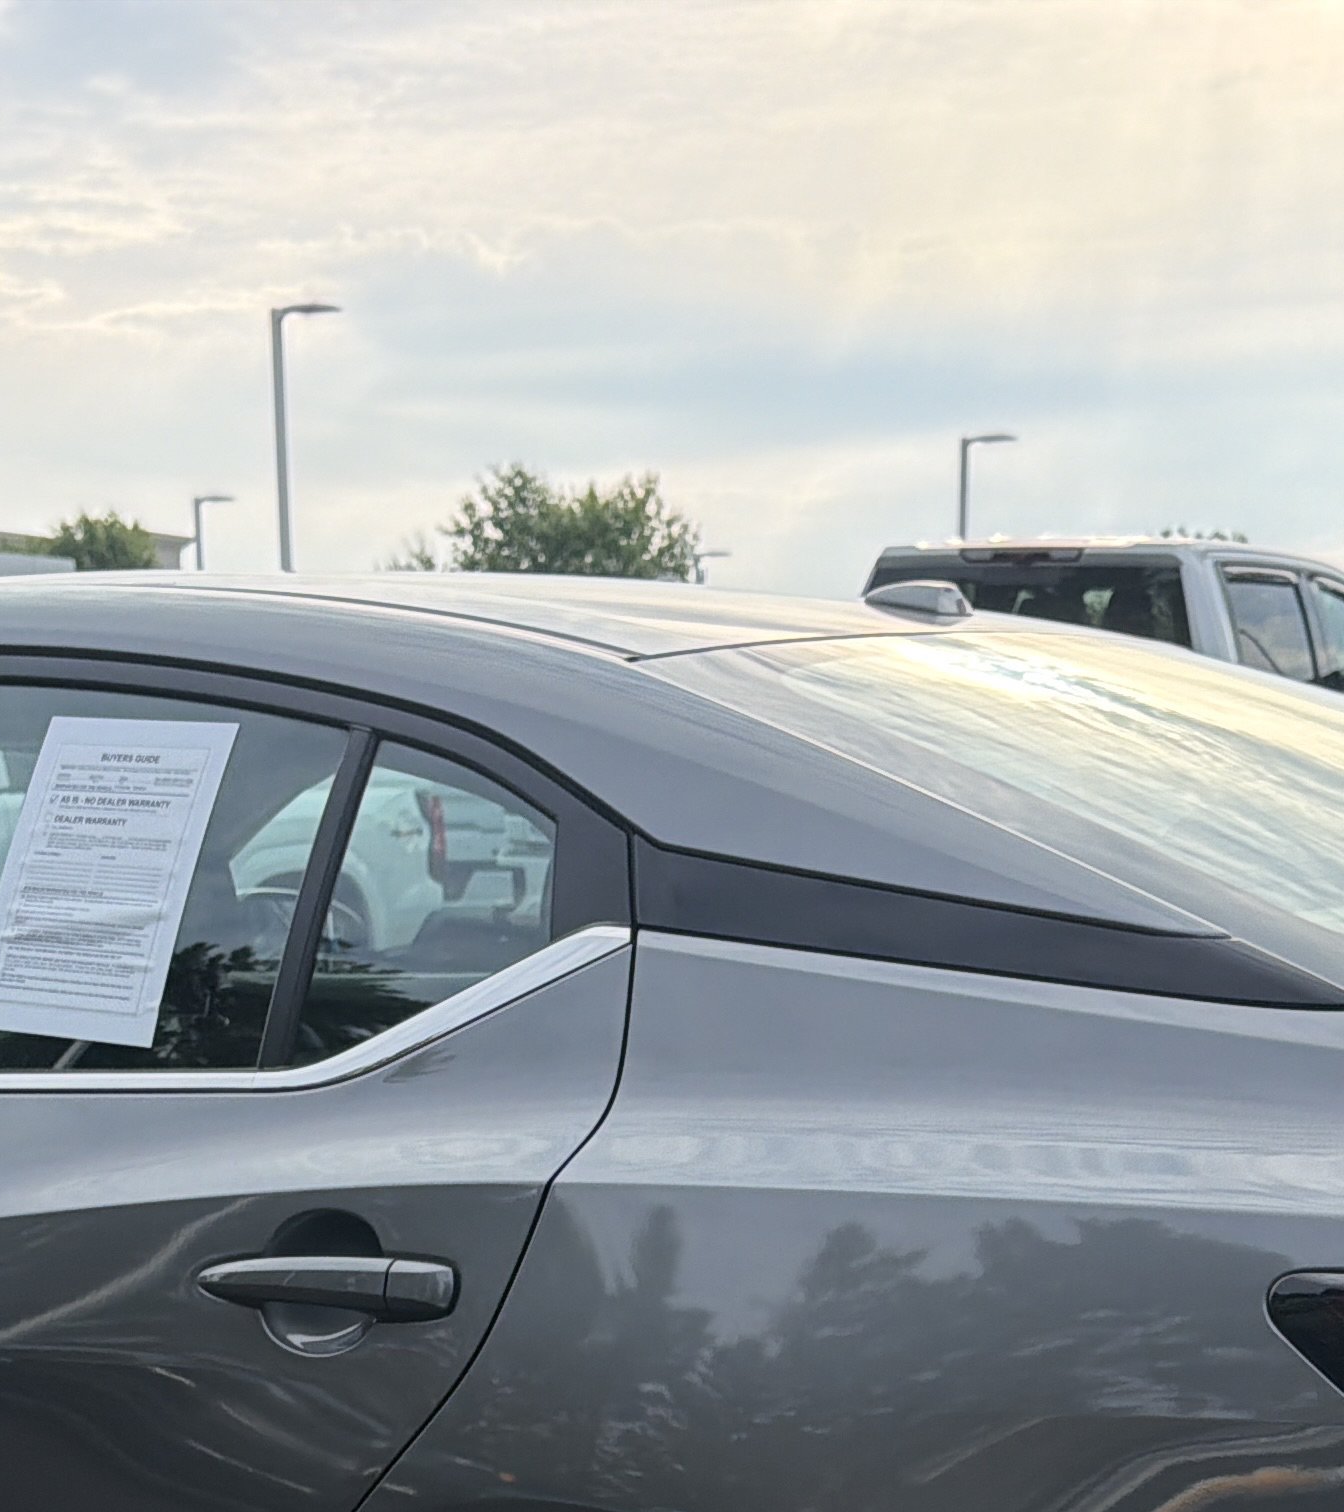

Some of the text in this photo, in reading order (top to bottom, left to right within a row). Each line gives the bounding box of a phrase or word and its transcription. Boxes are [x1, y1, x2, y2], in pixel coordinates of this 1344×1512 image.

[101, 753, 160, 764] BUYERS GUIDE
[85, 797, 96, 805] NO
[97, 798, 126, 807] DEALER
[128, 799, 171, 808] WARRANTY
[54, 815, 128, 826] DEALER WARRANTY
